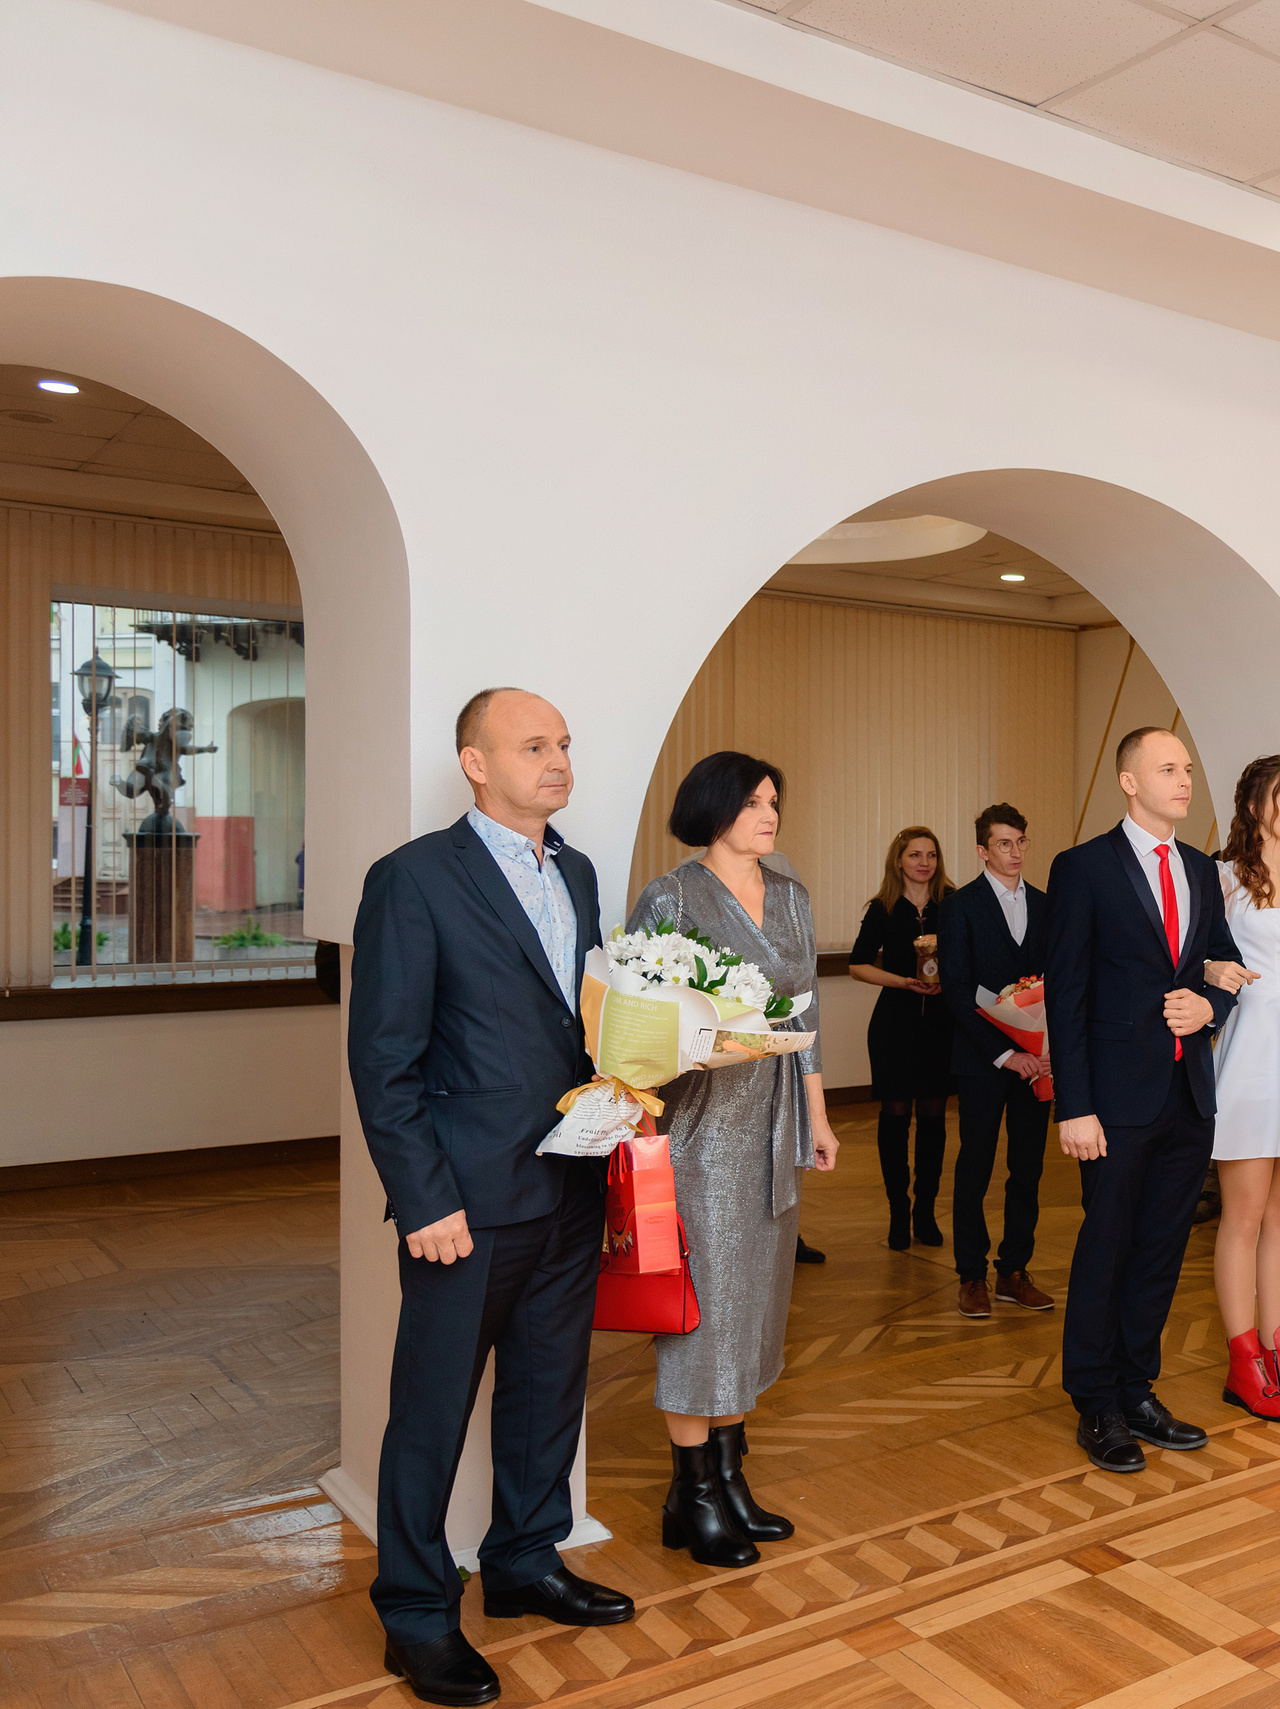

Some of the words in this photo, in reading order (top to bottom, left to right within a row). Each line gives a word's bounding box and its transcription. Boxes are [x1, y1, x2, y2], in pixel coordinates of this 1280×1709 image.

[623, 999, 640, 1009] AND
[640, 1002, 658, 1012] RICH
[630, 1074, 647, 1084] AND
